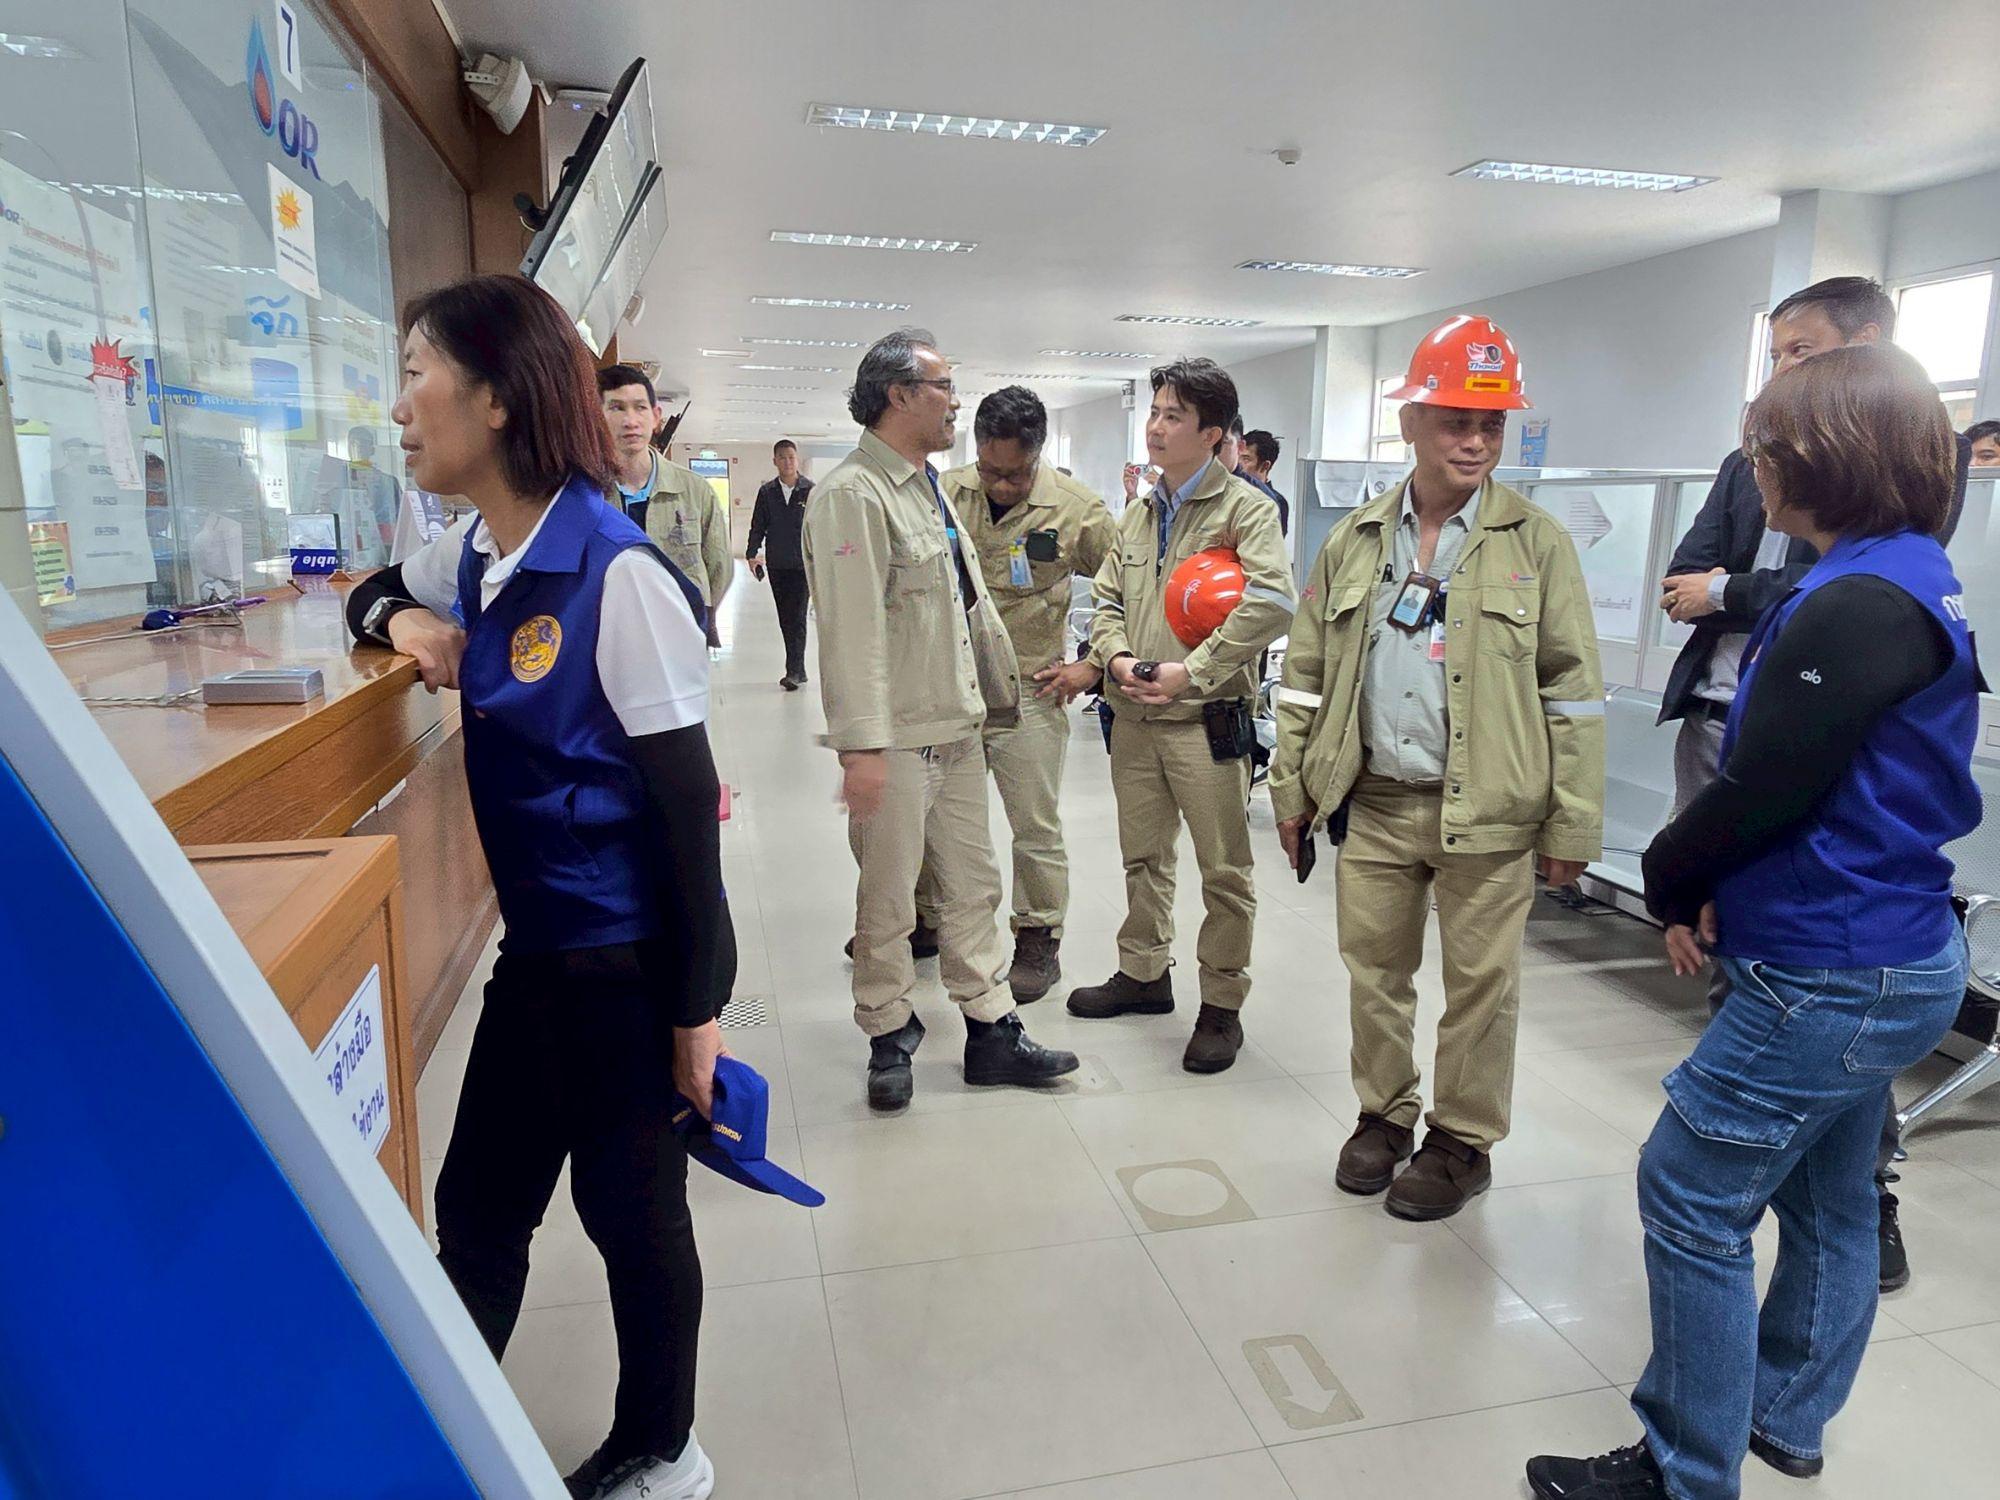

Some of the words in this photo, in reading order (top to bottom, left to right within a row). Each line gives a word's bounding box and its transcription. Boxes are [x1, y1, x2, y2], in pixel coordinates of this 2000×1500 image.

[281, 6, 292, 74] 7
[279, 98, 321, 181] OR
[1800, 668, 1822, 685] alo
